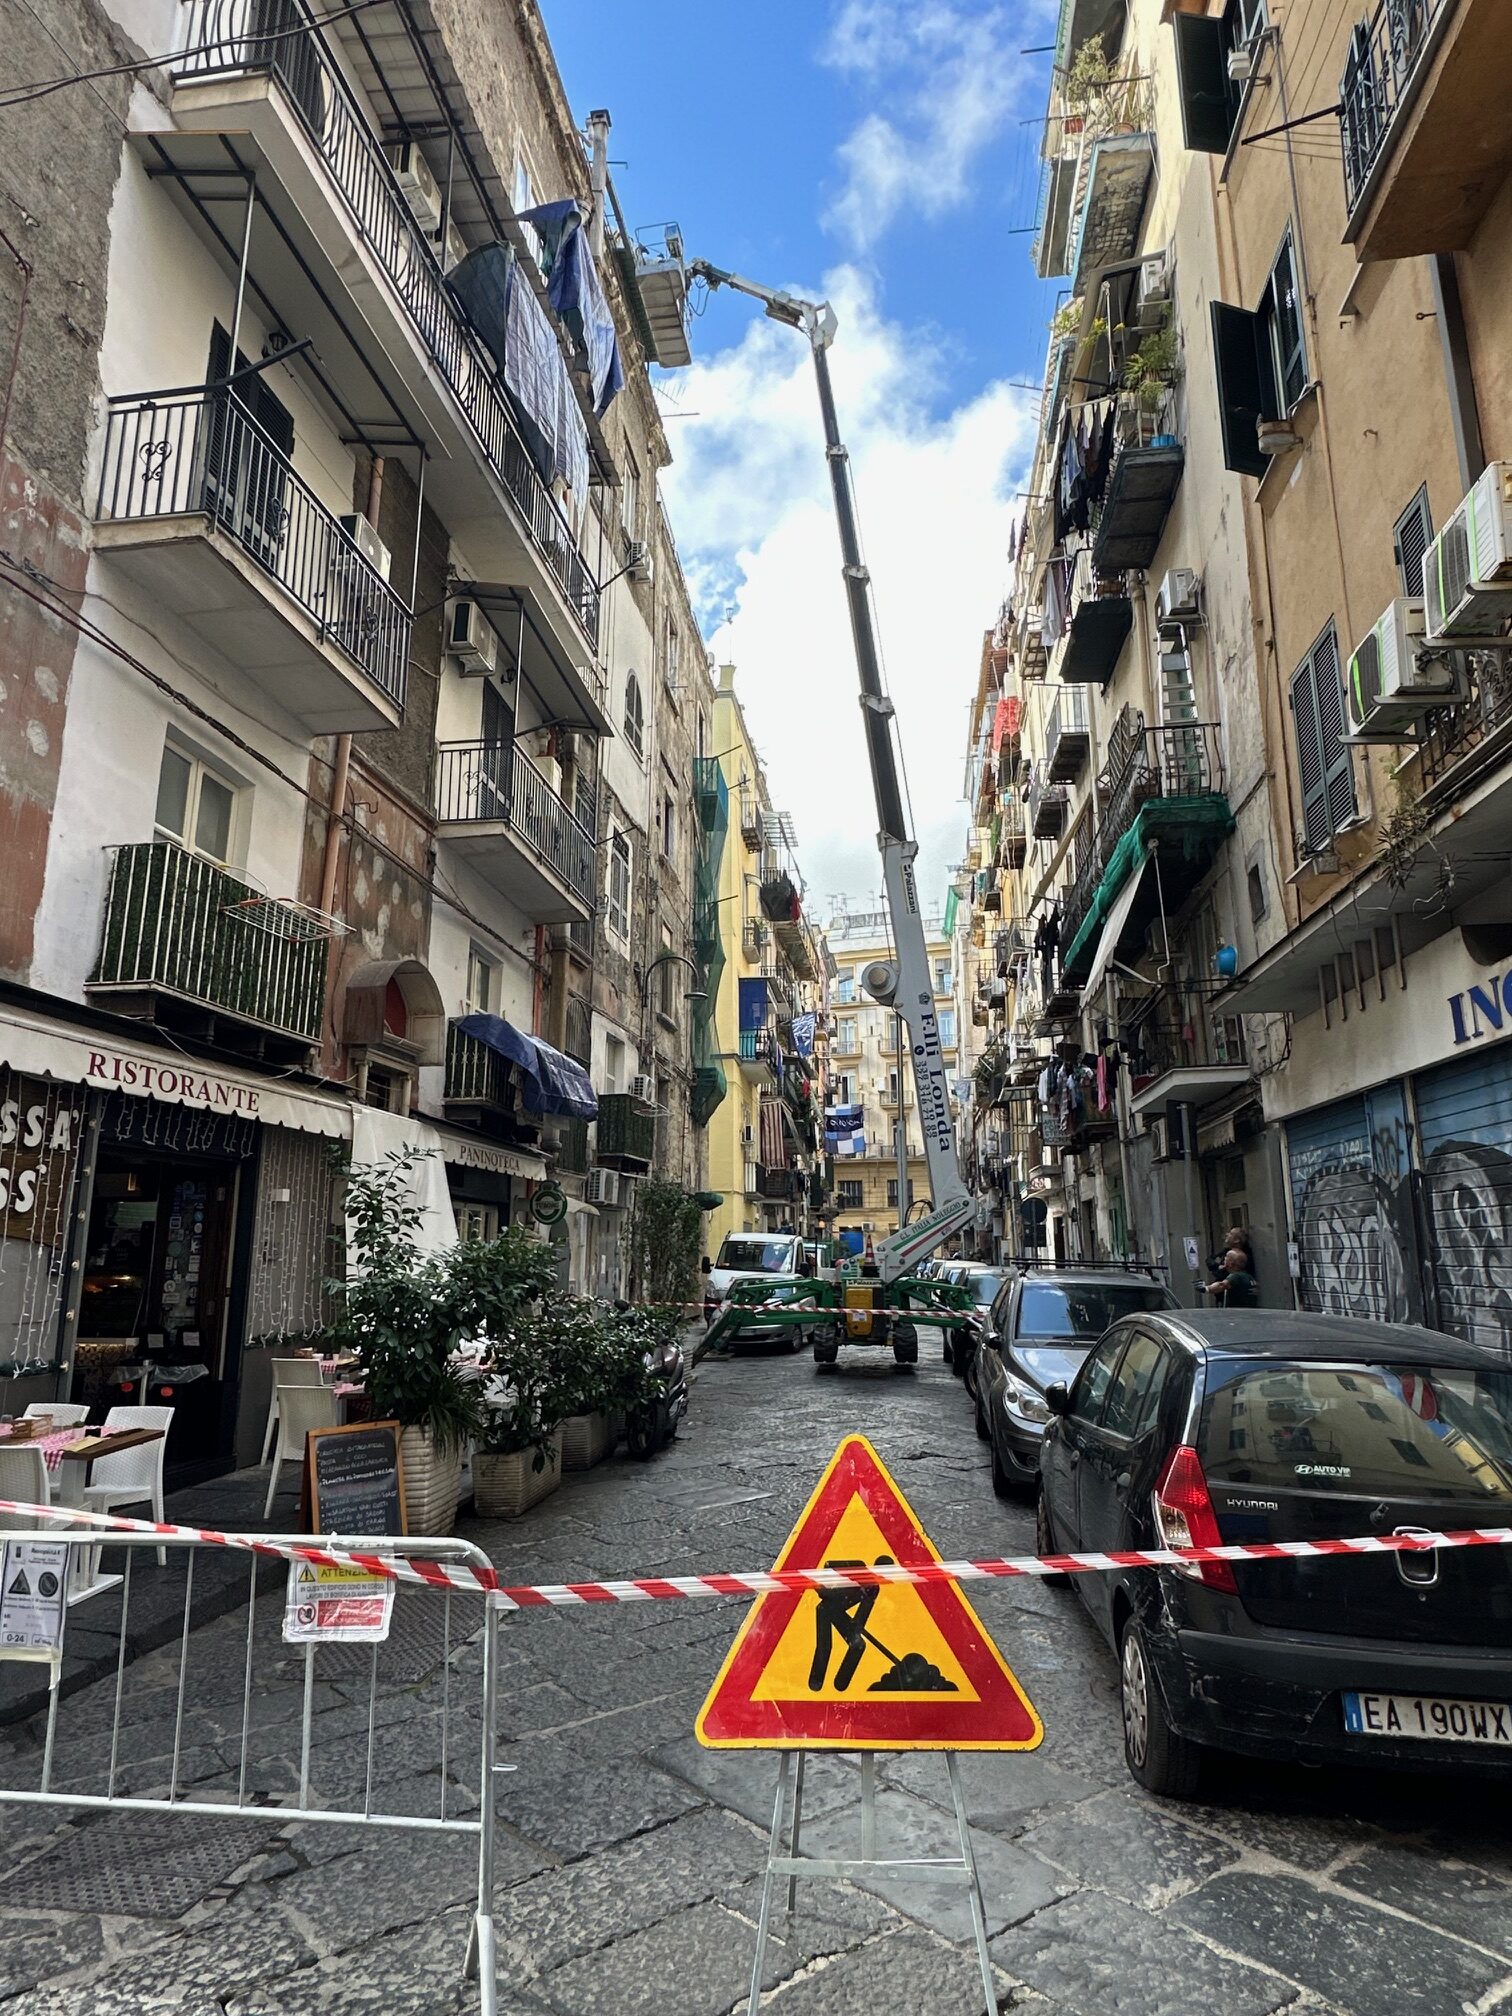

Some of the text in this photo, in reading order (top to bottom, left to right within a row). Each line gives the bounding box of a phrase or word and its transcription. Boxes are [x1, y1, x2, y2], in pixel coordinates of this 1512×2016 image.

[1447, 969, 1512, 1045] IN
[87, 1052, 260, 1113] RISTORANTE
[921, 1013, 952, 1153] F.lli Londa
[460, 1145, 520, 1171] PANINOTECA
[912, 1220, 930, 1234] ITALIA
[1314, 1465, 1351, 1475] AUTO VIP
[1227, 1498, 1279, 1511] HYUNDAI
[1364, 1697, 1402, 1731] EA
